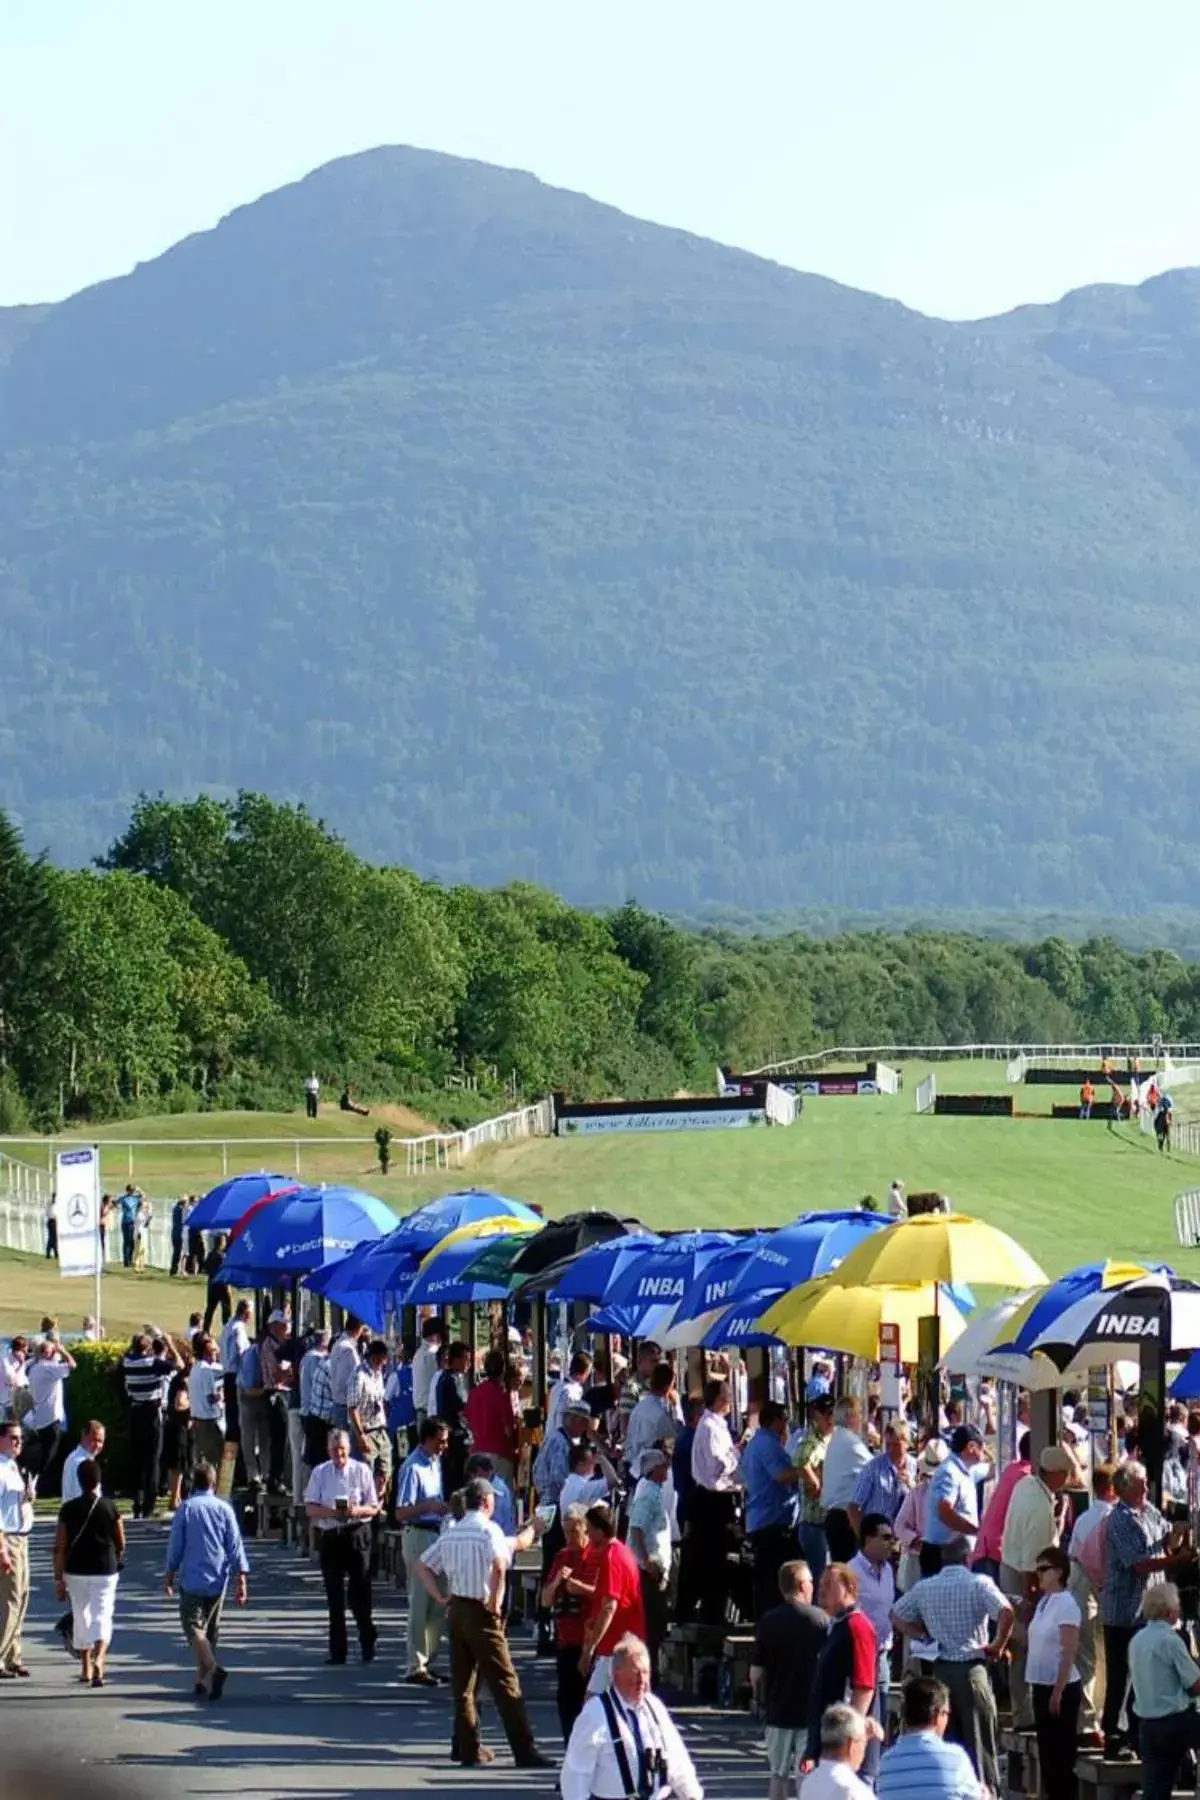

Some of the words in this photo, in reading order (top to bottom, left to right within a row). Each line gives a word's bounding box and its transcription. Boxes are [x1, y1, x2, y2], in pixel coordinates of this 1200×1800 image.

[637, 1278, 685, 1297] INBA
[705, 1280, 733, 1303] IN
[727, 1317, 752, 1337] IN
[1096, 1314, 1160, 1336] INBA
